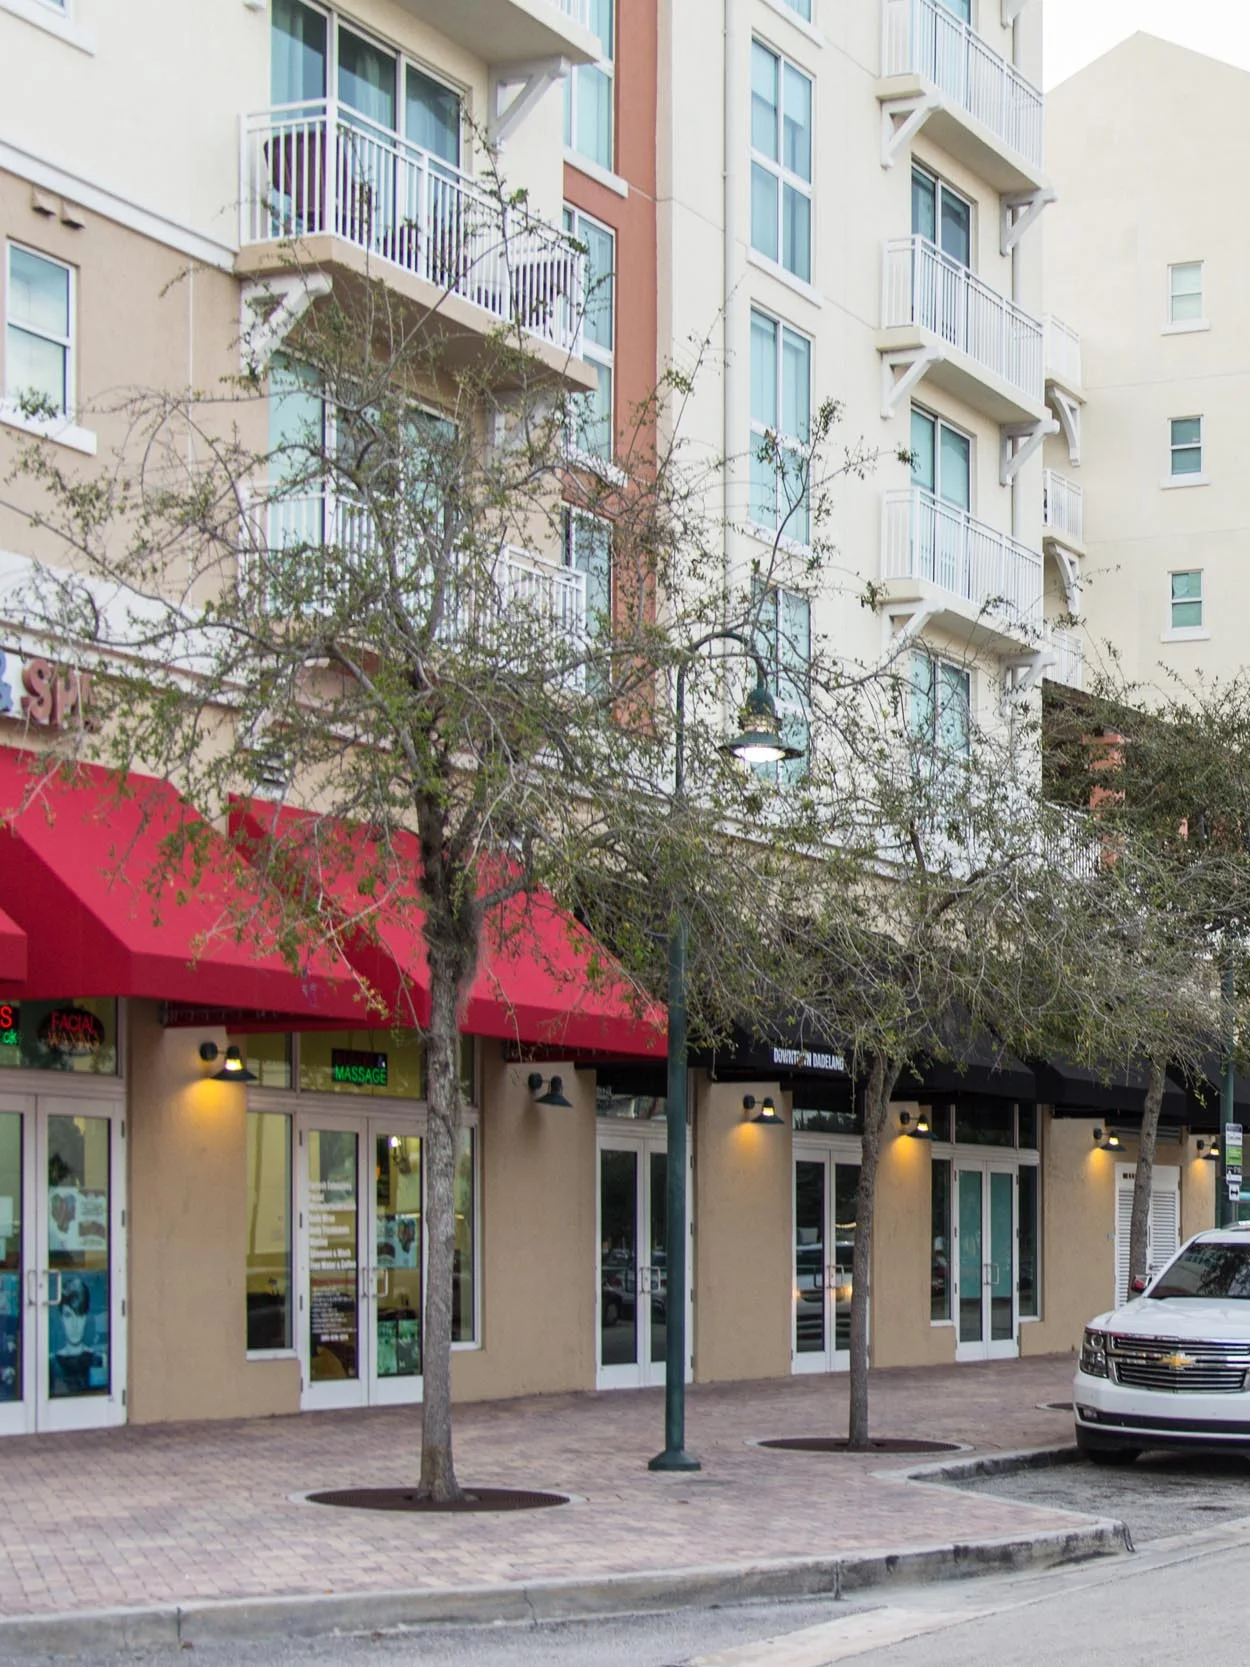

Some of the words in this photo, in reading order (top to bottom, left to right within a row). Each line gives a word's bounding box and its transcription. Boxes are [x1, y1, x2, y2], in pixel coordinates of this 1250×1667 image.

[51, 1011, 97, 1034] FACIAL
[812, 1052, 845, 1071] DADELAND
[335, 1064, 386, 1085] MASSAGE
